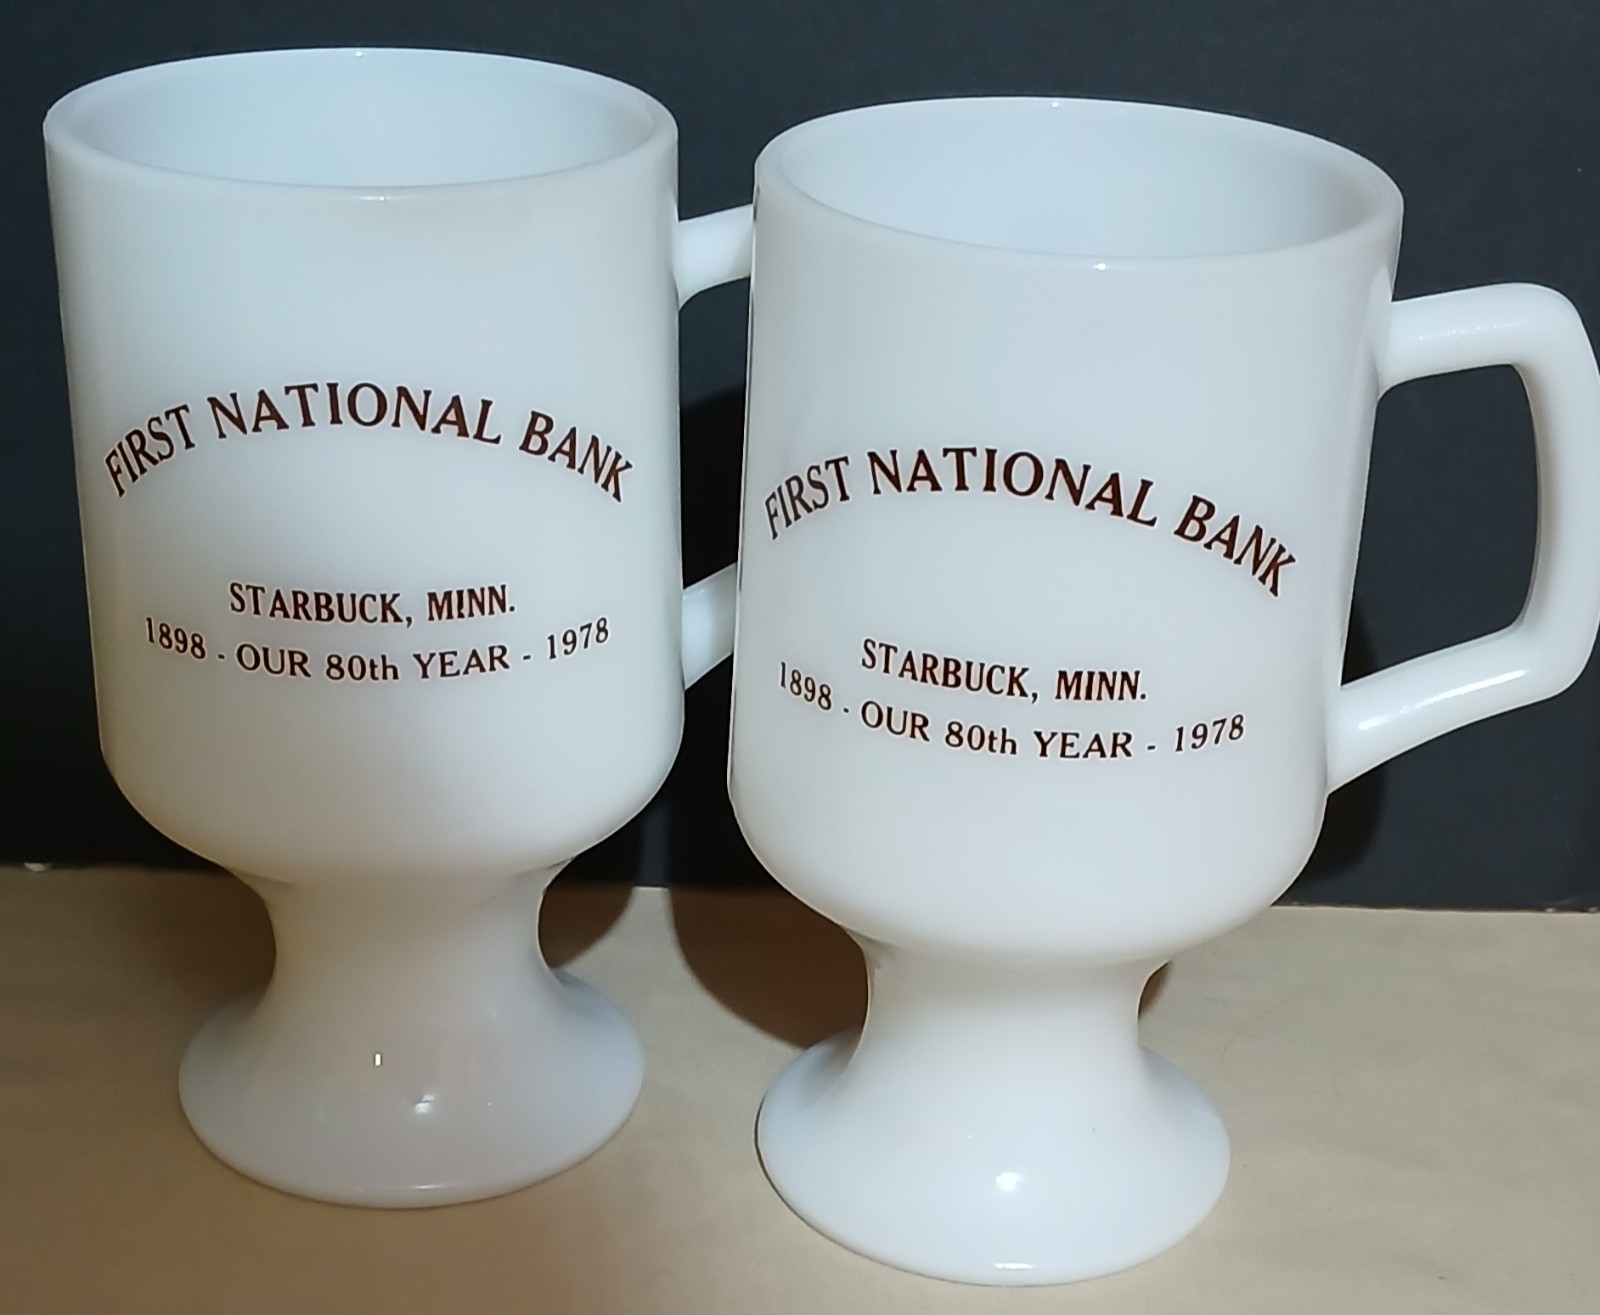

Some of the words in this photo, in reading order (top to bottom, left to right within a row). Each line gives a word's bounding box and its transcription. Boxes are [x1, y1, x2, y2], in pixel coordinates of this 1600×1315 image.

[105, 403, 196, 498] FIRST
[206, 382, 502, 445] NATIONAL
[518, 409, 633, 503] BANK
[764, 455, 851, 541] FIRST
[866, 446, 1158, 528] NATIONAL
[1172, 494, 1297, 598] BANK
[229, 581, 413, 629] STARBUCK,
[427, 583, 516, 622] MINN.
[146, 616, 206, 660] 1898
[236, 643, 312, 678] OUR
[325, 653, 400, 681] 80th
[412, 644, 511, 680] YEAR
[547, 616, 609, 660] 1978
[861, 638, 1038, 705] STARBUCK,
[1054, 669, 1147, 702] MINN.
[780, 661, 832, 711] 1898
[860, 700, 931, 743] OUR
[944, 720, 1018, 756] 80th
[1032, 730, 1133, 759] YEAR
[1174, 713, 1244, 753] 1978
